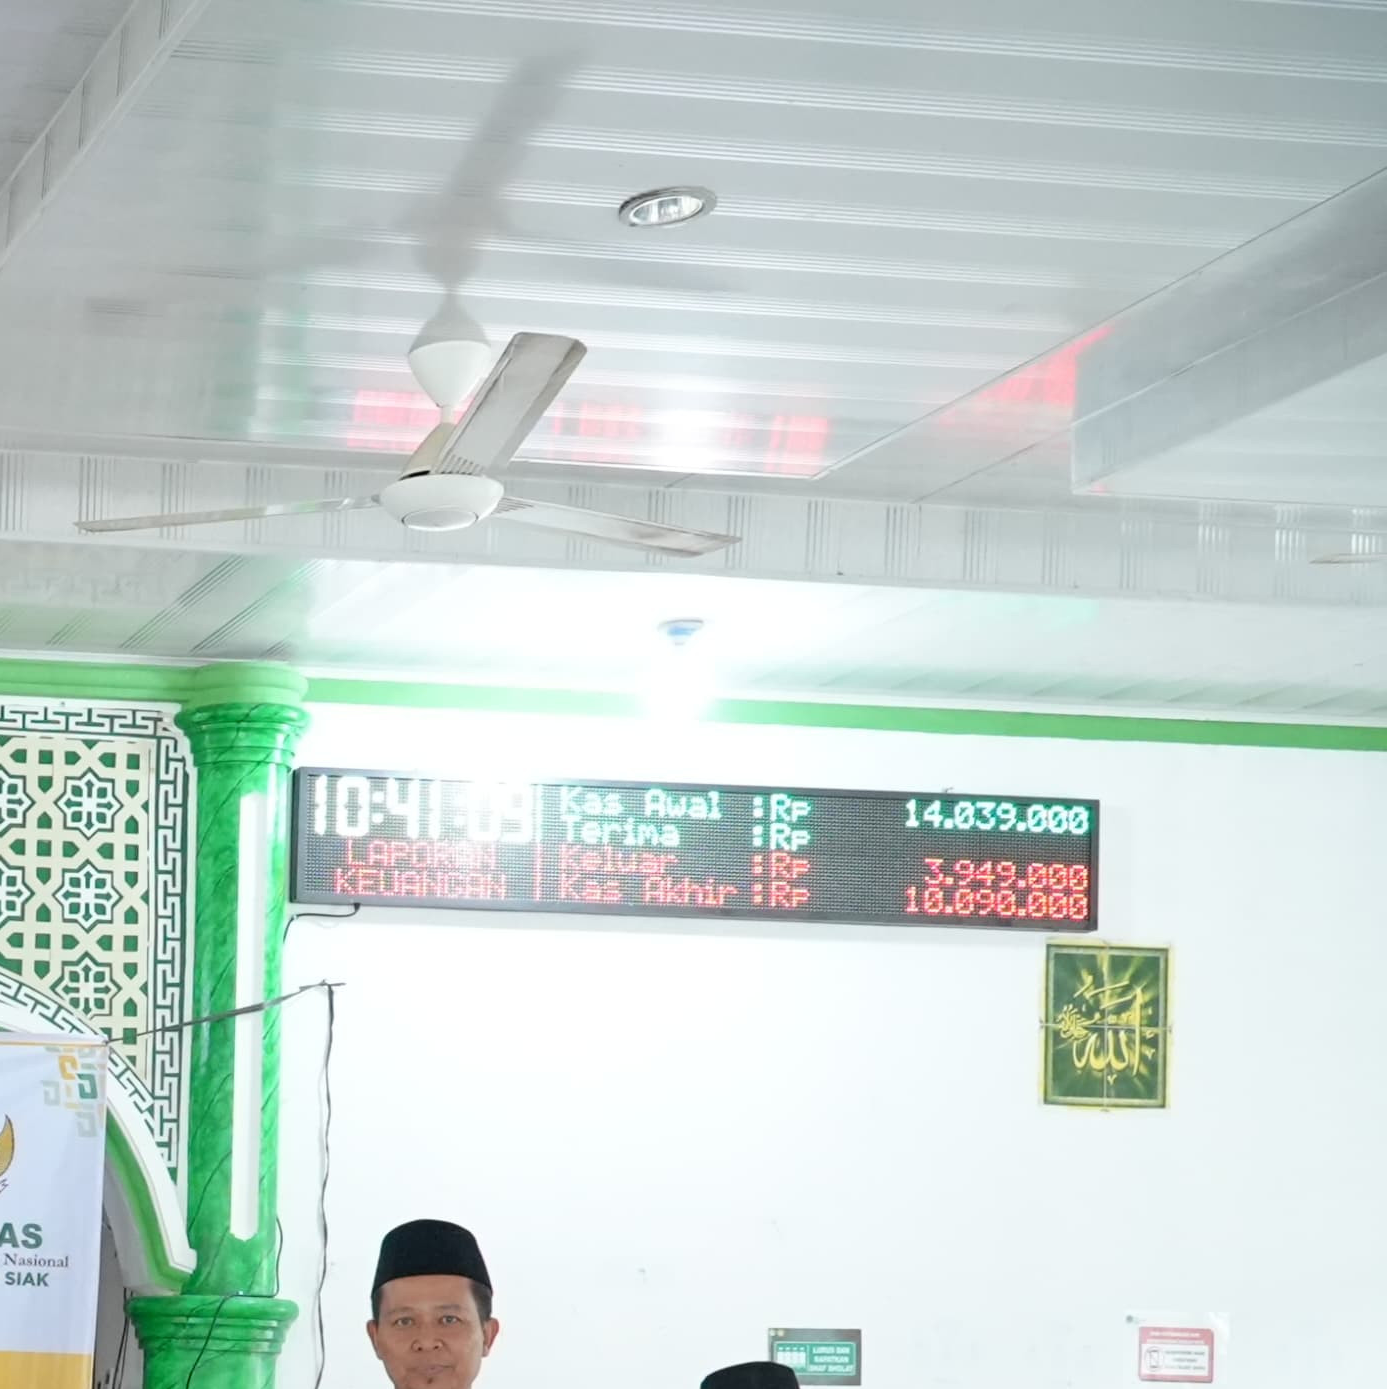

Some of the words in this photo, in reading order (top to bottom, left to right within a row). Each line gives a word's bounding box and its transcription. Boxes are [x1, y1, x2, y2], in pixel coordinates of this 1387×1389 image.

[560, 786, 624, 816] Kas
[644, 789, 722, 820] Awal
[905, 798, 1090, 835] 14.039.000
[560, 815, 680, 847] Terima
[334, 868, 507, 899] KEUANGAN
[559, 844, 678, 875] Keluar
[924, 858, 1089, 891] 3.949.000
[560, 872, 623, 902] Kas
[643, 876, 739, 907] Akhir
[905, 887, 1089, 921] 10.090.000
[4, 1253, 70, 1269] Nasional
[5, 1271, 50, 1288] SIAK
